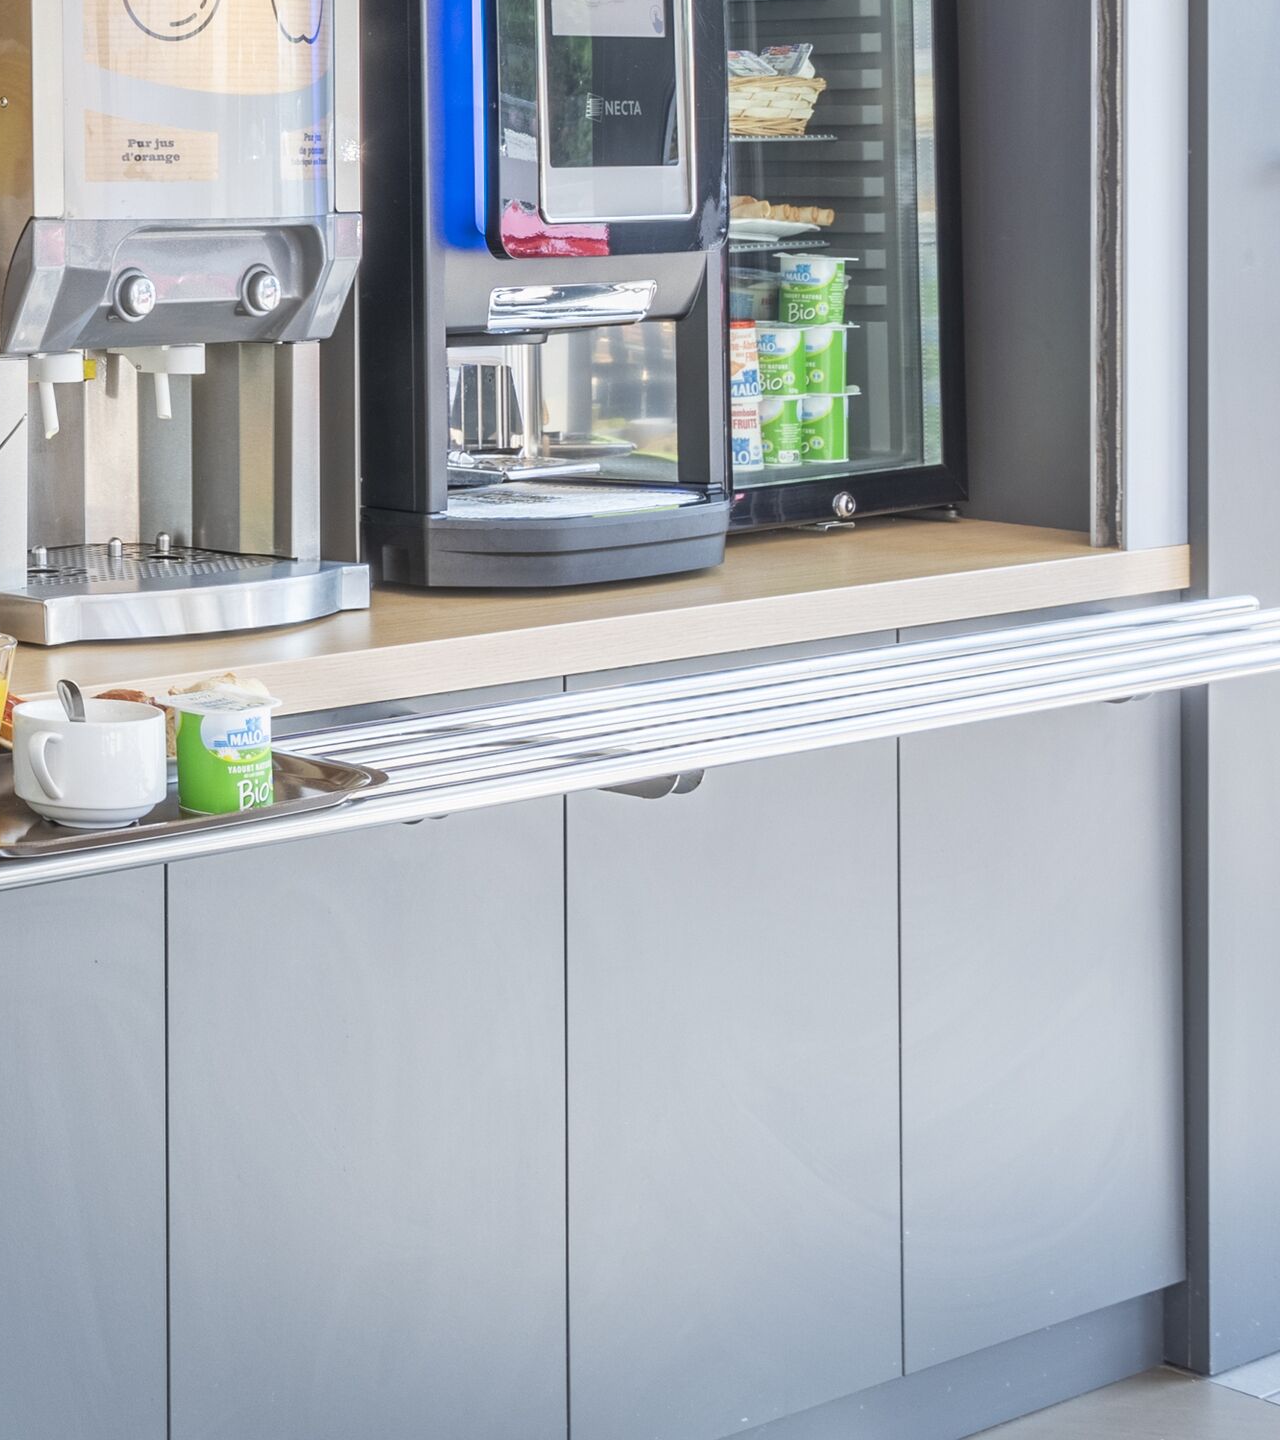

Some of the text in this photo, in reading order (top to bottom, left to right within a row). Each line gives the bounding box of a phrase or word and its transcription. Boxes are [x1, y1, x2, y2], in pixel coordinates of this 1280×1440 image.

[604, 99, 642, 117] NECTA
[128, 138, 174, 150] Pur jus
[122, 152, 180, 164] d'orange
[786, 272, 810, 282] MALO
[788, 302, 816, 322] Bio
[757, 342, 776, 352] ALO
[229, 730, 262, 746] MALO
[227, 764, 254, 774] YAOURT
[237, 779, 270, 812] Bio
